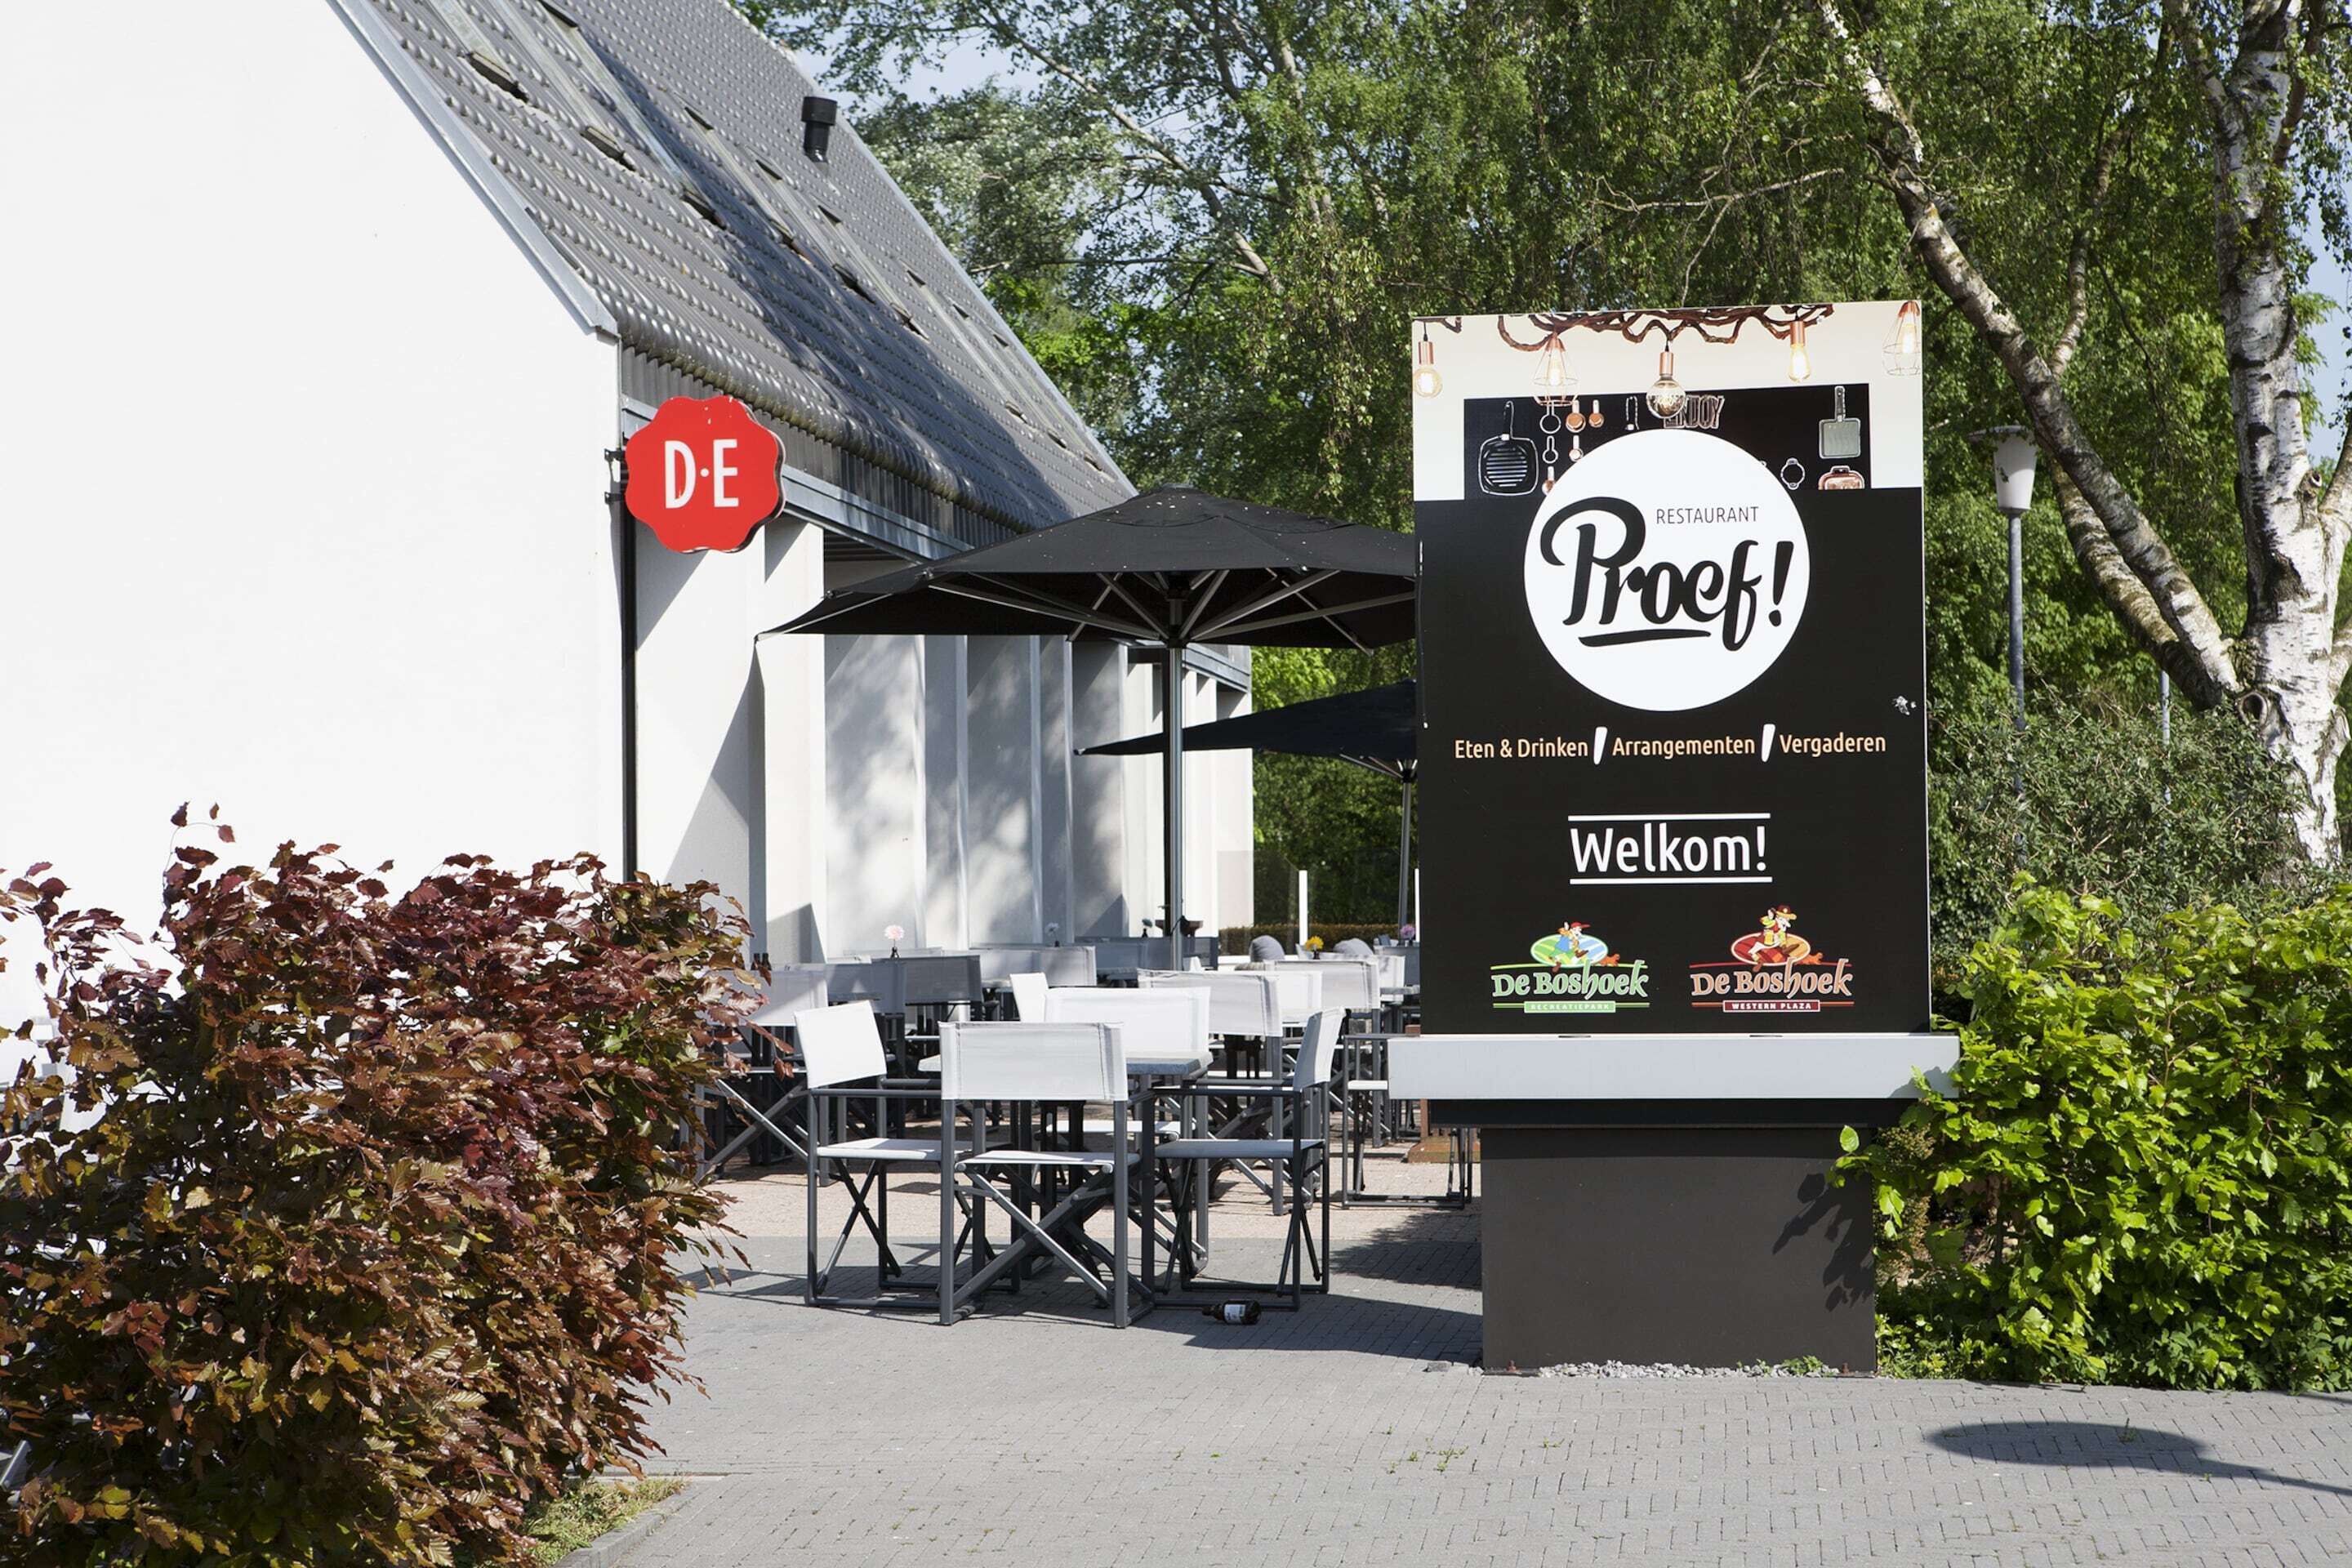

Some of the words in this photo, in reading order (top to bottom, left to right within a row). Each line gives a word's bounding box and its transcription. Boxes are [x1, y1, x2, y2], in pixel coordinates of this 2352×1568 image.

[1656, 506, 1759, 524] RESTAURANT
[1539, 496, 1794, 652] Proef!
[1454, 739, 1494, 759] Eten
[1499, 738, 1512, 758] &
[1517, 737, 1588, 758] Drinken
[1612, 736, 1755, 760] Arrangementen
[1779, 732, 1886, 758] Vergaderen
[1570, 822, 1766, 873] Welkom!
[1490, 973, 1530, 998] De
[1532, 959, 1650, 1000] Boshoek
[1690, 972, 1731, 996] De
[1733, 956, 1854, 1000] Boshoek
[1530, 1003, 1610, 1011] RECREATIEPARK
